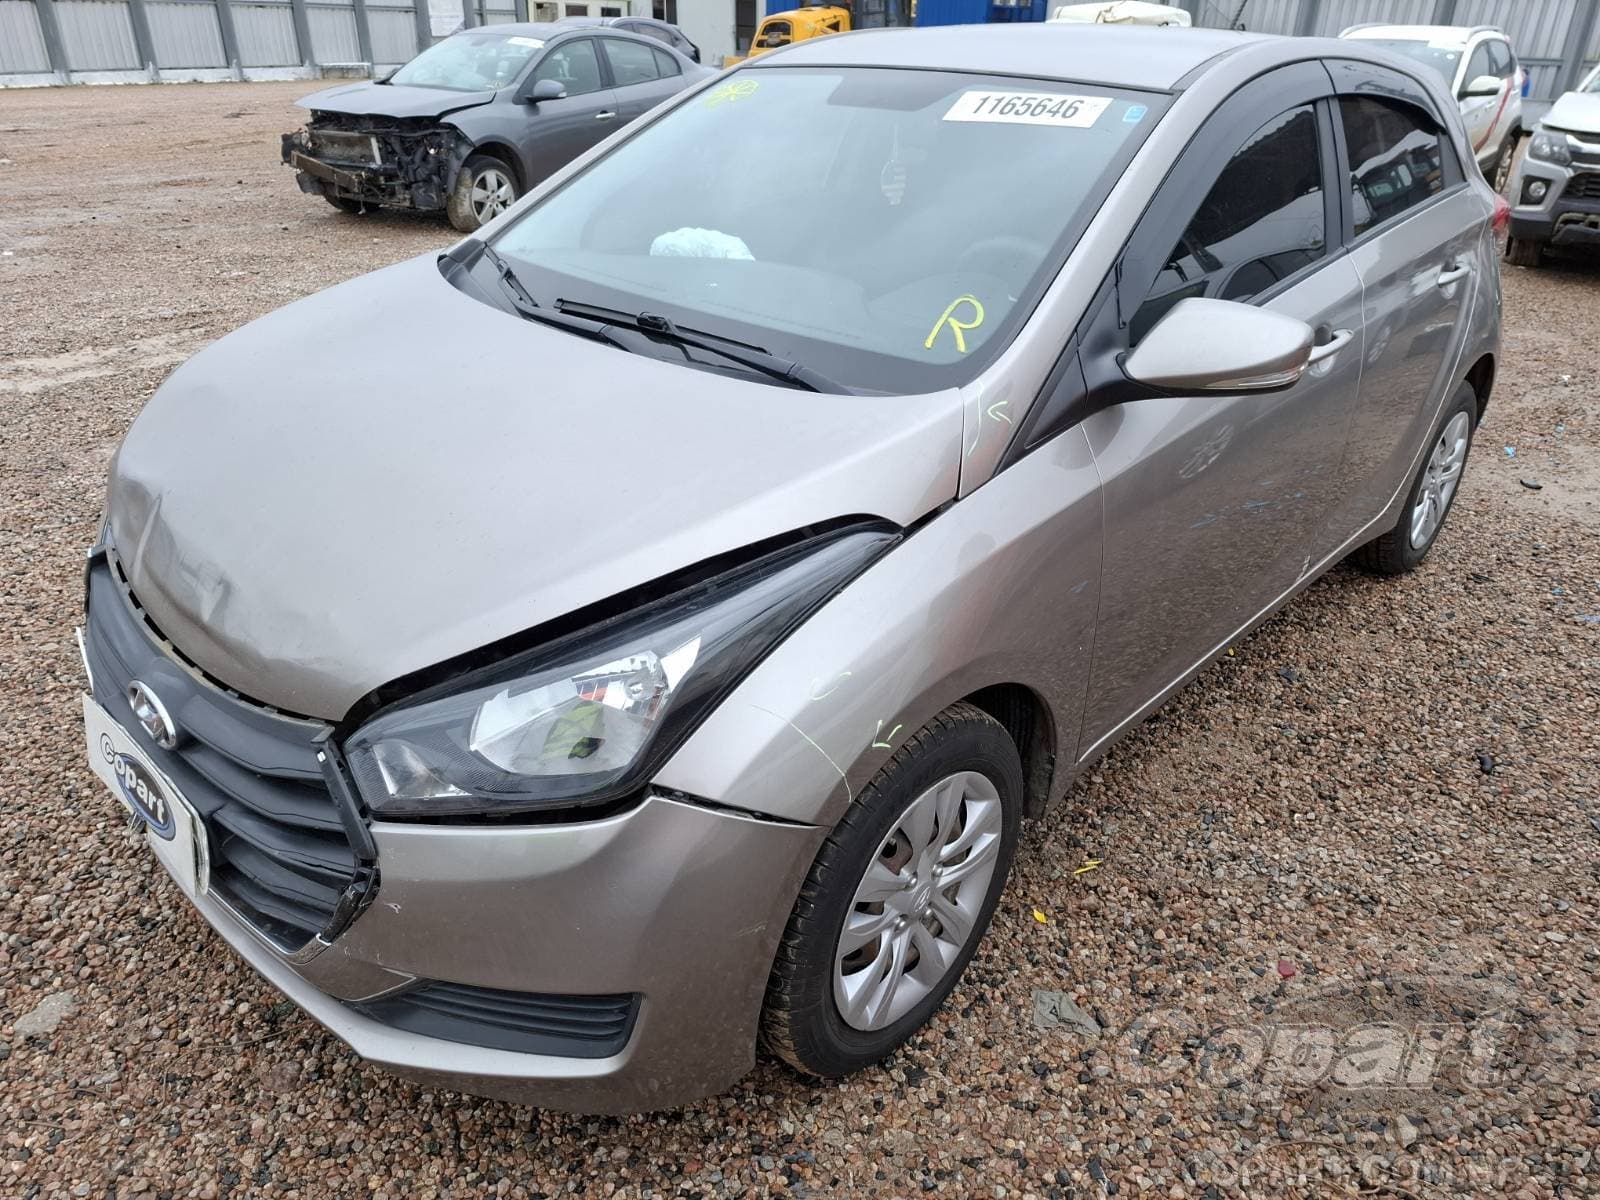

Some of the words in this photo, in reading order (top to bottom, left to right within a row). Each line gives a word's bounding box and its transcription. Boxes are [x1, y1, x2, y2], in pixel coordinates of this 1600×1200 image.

[973, 95, 1084, 119] 1165646
[924, 294, 985, 353] R
[100, 732, 165, 825] Copart
